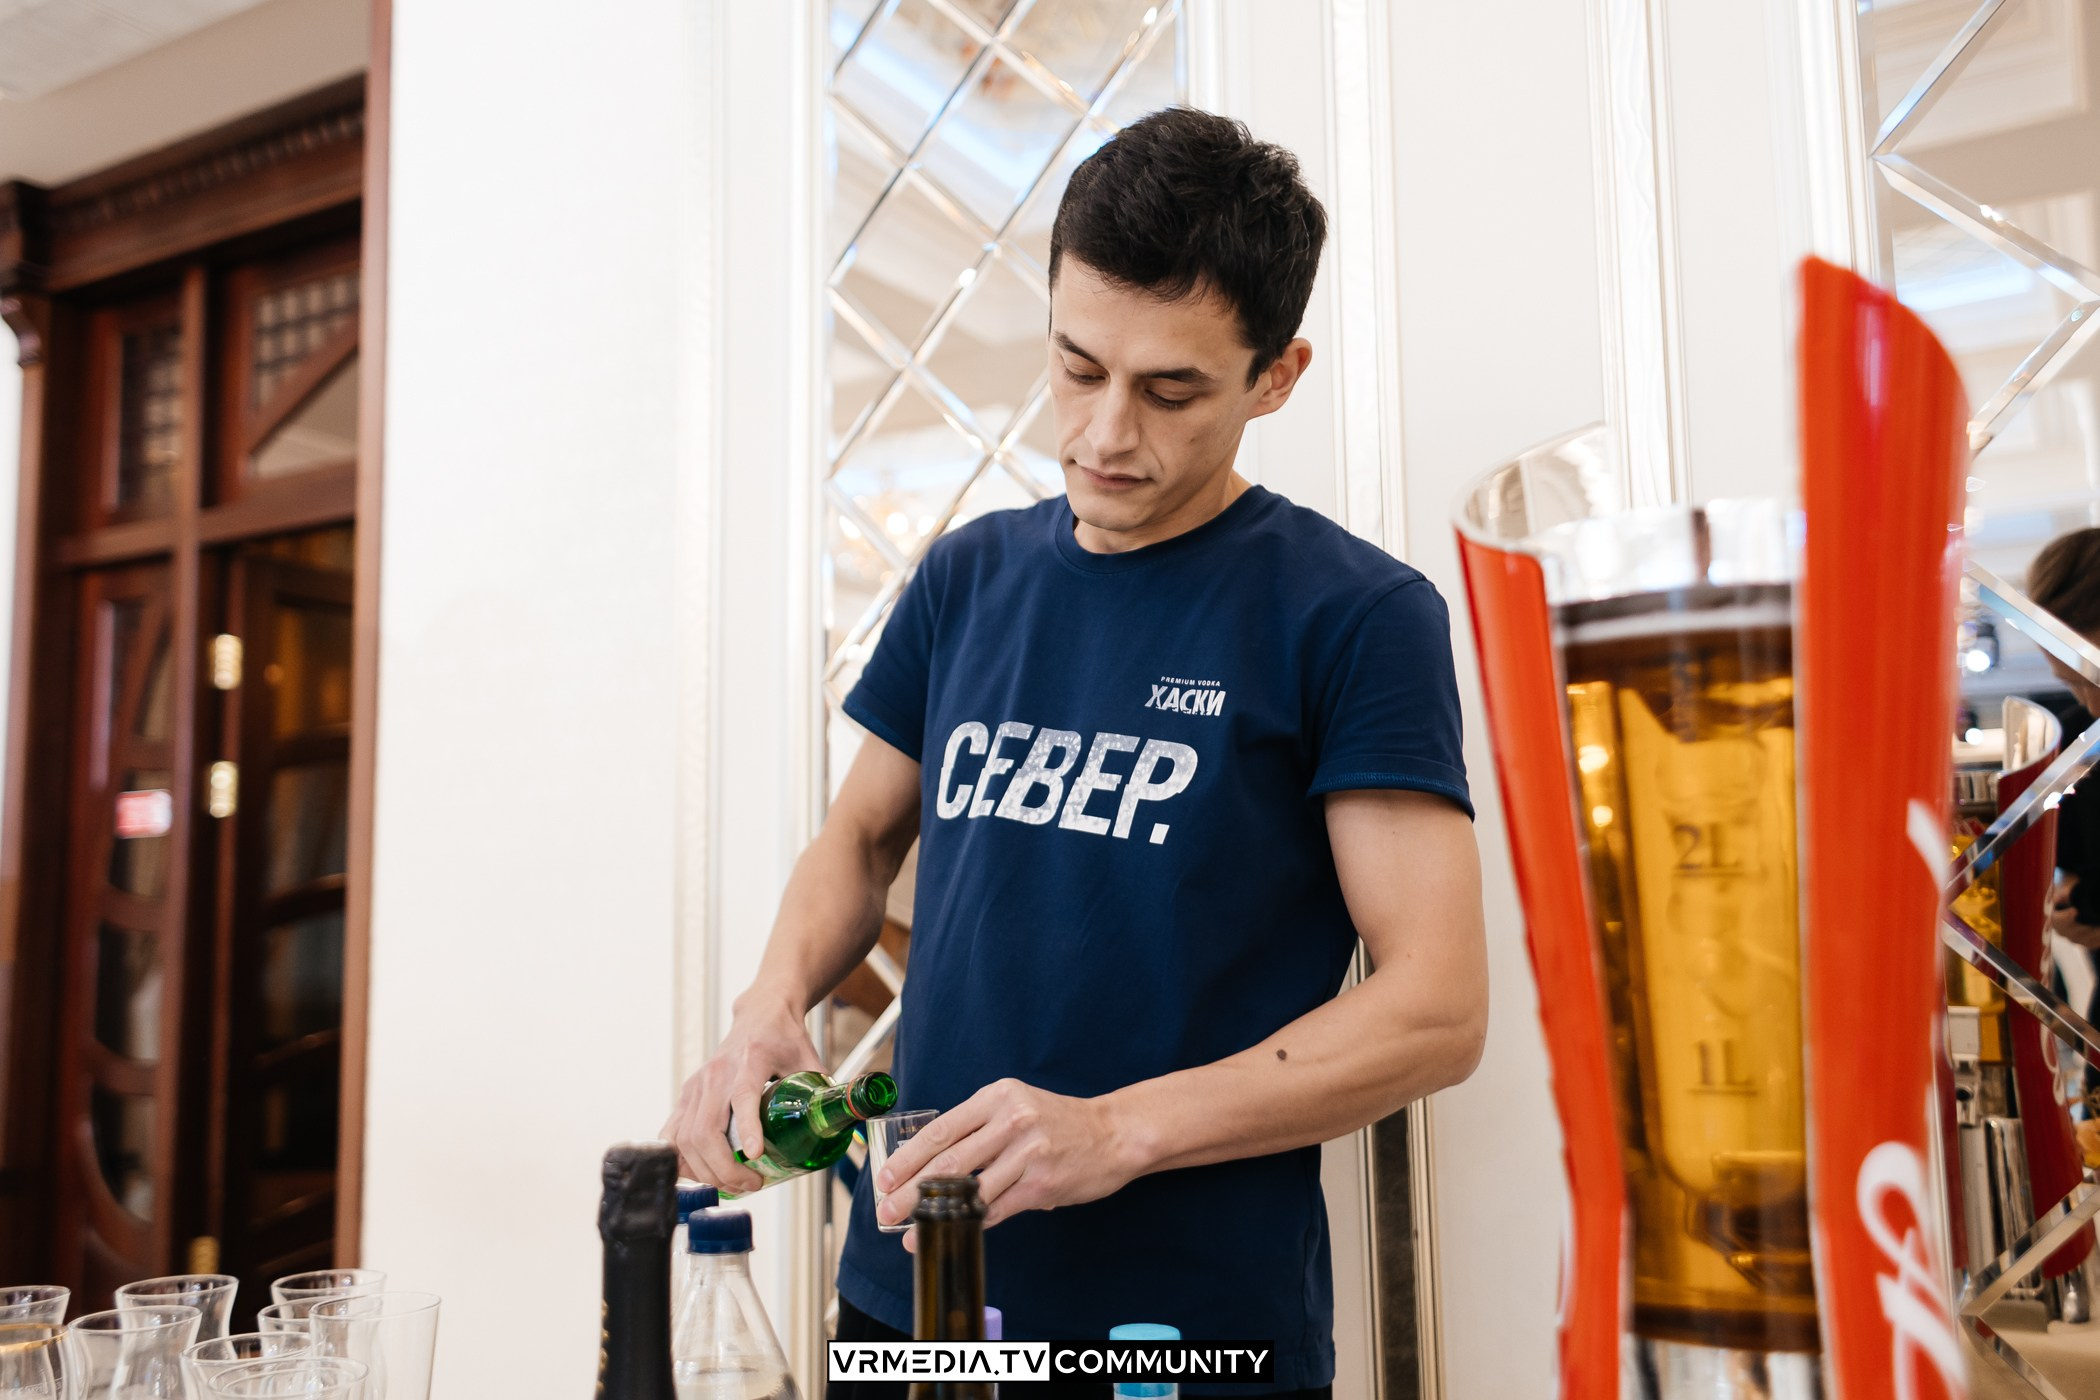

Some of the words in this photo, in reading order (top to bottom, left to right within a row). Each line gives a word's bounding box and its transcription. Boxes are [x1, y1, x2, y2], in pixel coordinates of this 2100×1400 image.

[1144, 684, 1226, 717] ХАСКИ
[1161, 676, 1196, 686] PREMIUM
[936, 720, 1199, 846] СЕВЕР.
[1673, 821, 1743, 870] 2L
[1692, 1037, 1756, 1087] 1L
